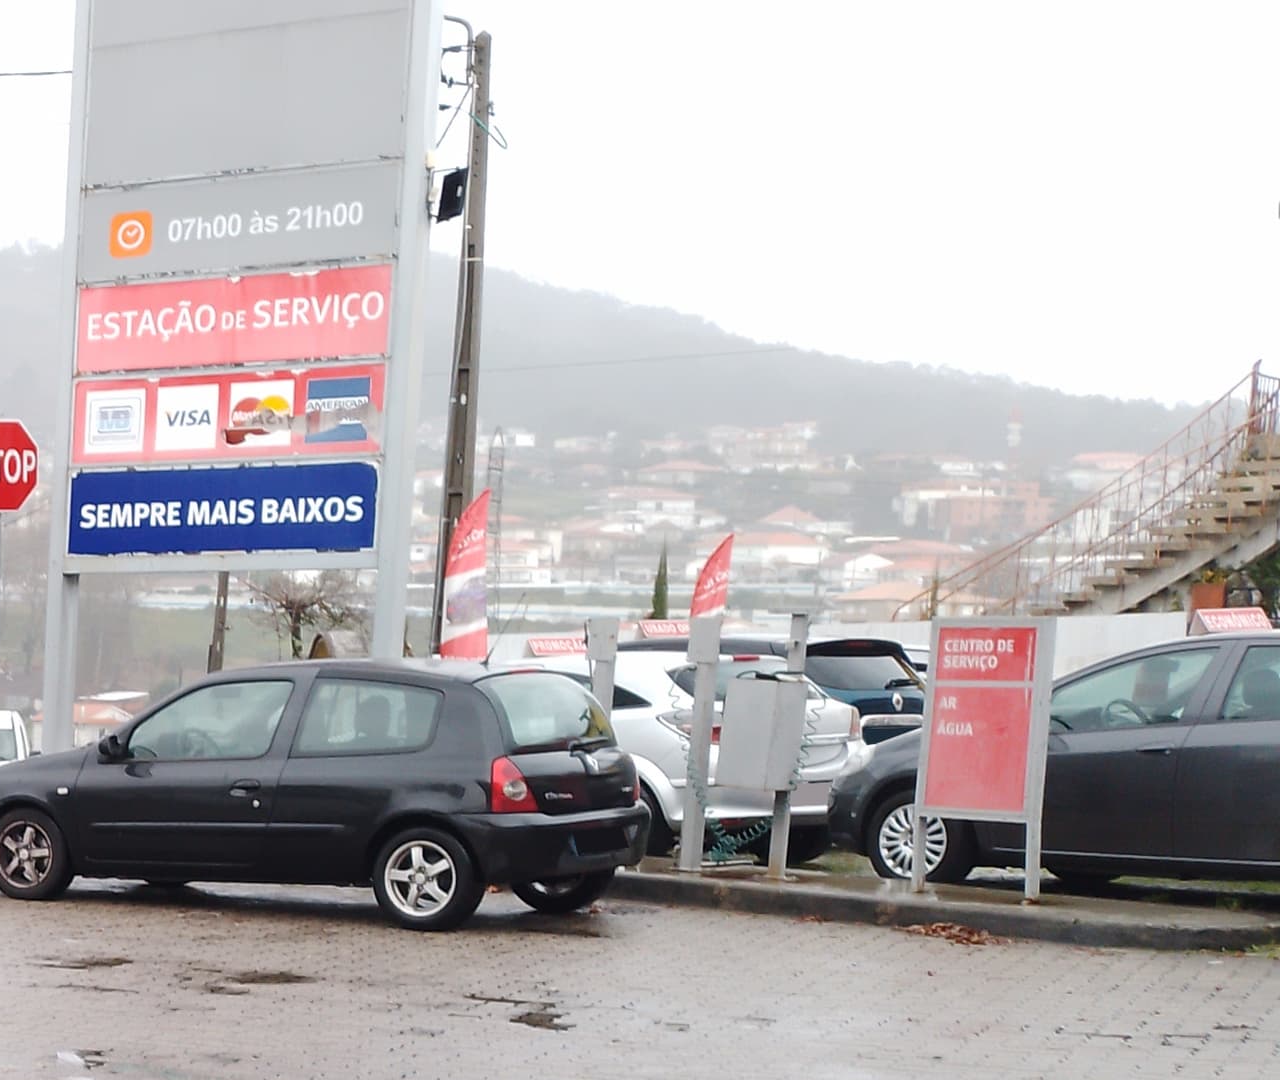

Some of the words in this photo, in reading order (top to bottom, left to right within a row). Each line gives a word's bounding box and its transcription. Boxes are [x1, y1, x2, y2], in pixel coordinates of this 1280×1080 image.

[167, 213, 242, 242] 07h00
[249, 210, 279, 235] às
[286, 202, 364, 232] 21h00
[86, 300, 217, 341] ESTAÇÃO
[221, 309, 247, 331] DE
[251, 291, 385, 329] SERVIÇO
[166, 409, 211, 427] VISA
[79, 501, 182, 529] SEMPRE
[186, 498, 255, 527] MAIS
[260, 496, 365, 524] BAIXOS
[944, 639, 994, 653] CENTRO
[997, 640, 1015, 653] DE
[943, 655, 998, 671] SERVIÇO
[940, 696, 958, 709] AR
[937, 718, 973, 737] ÁGUA
